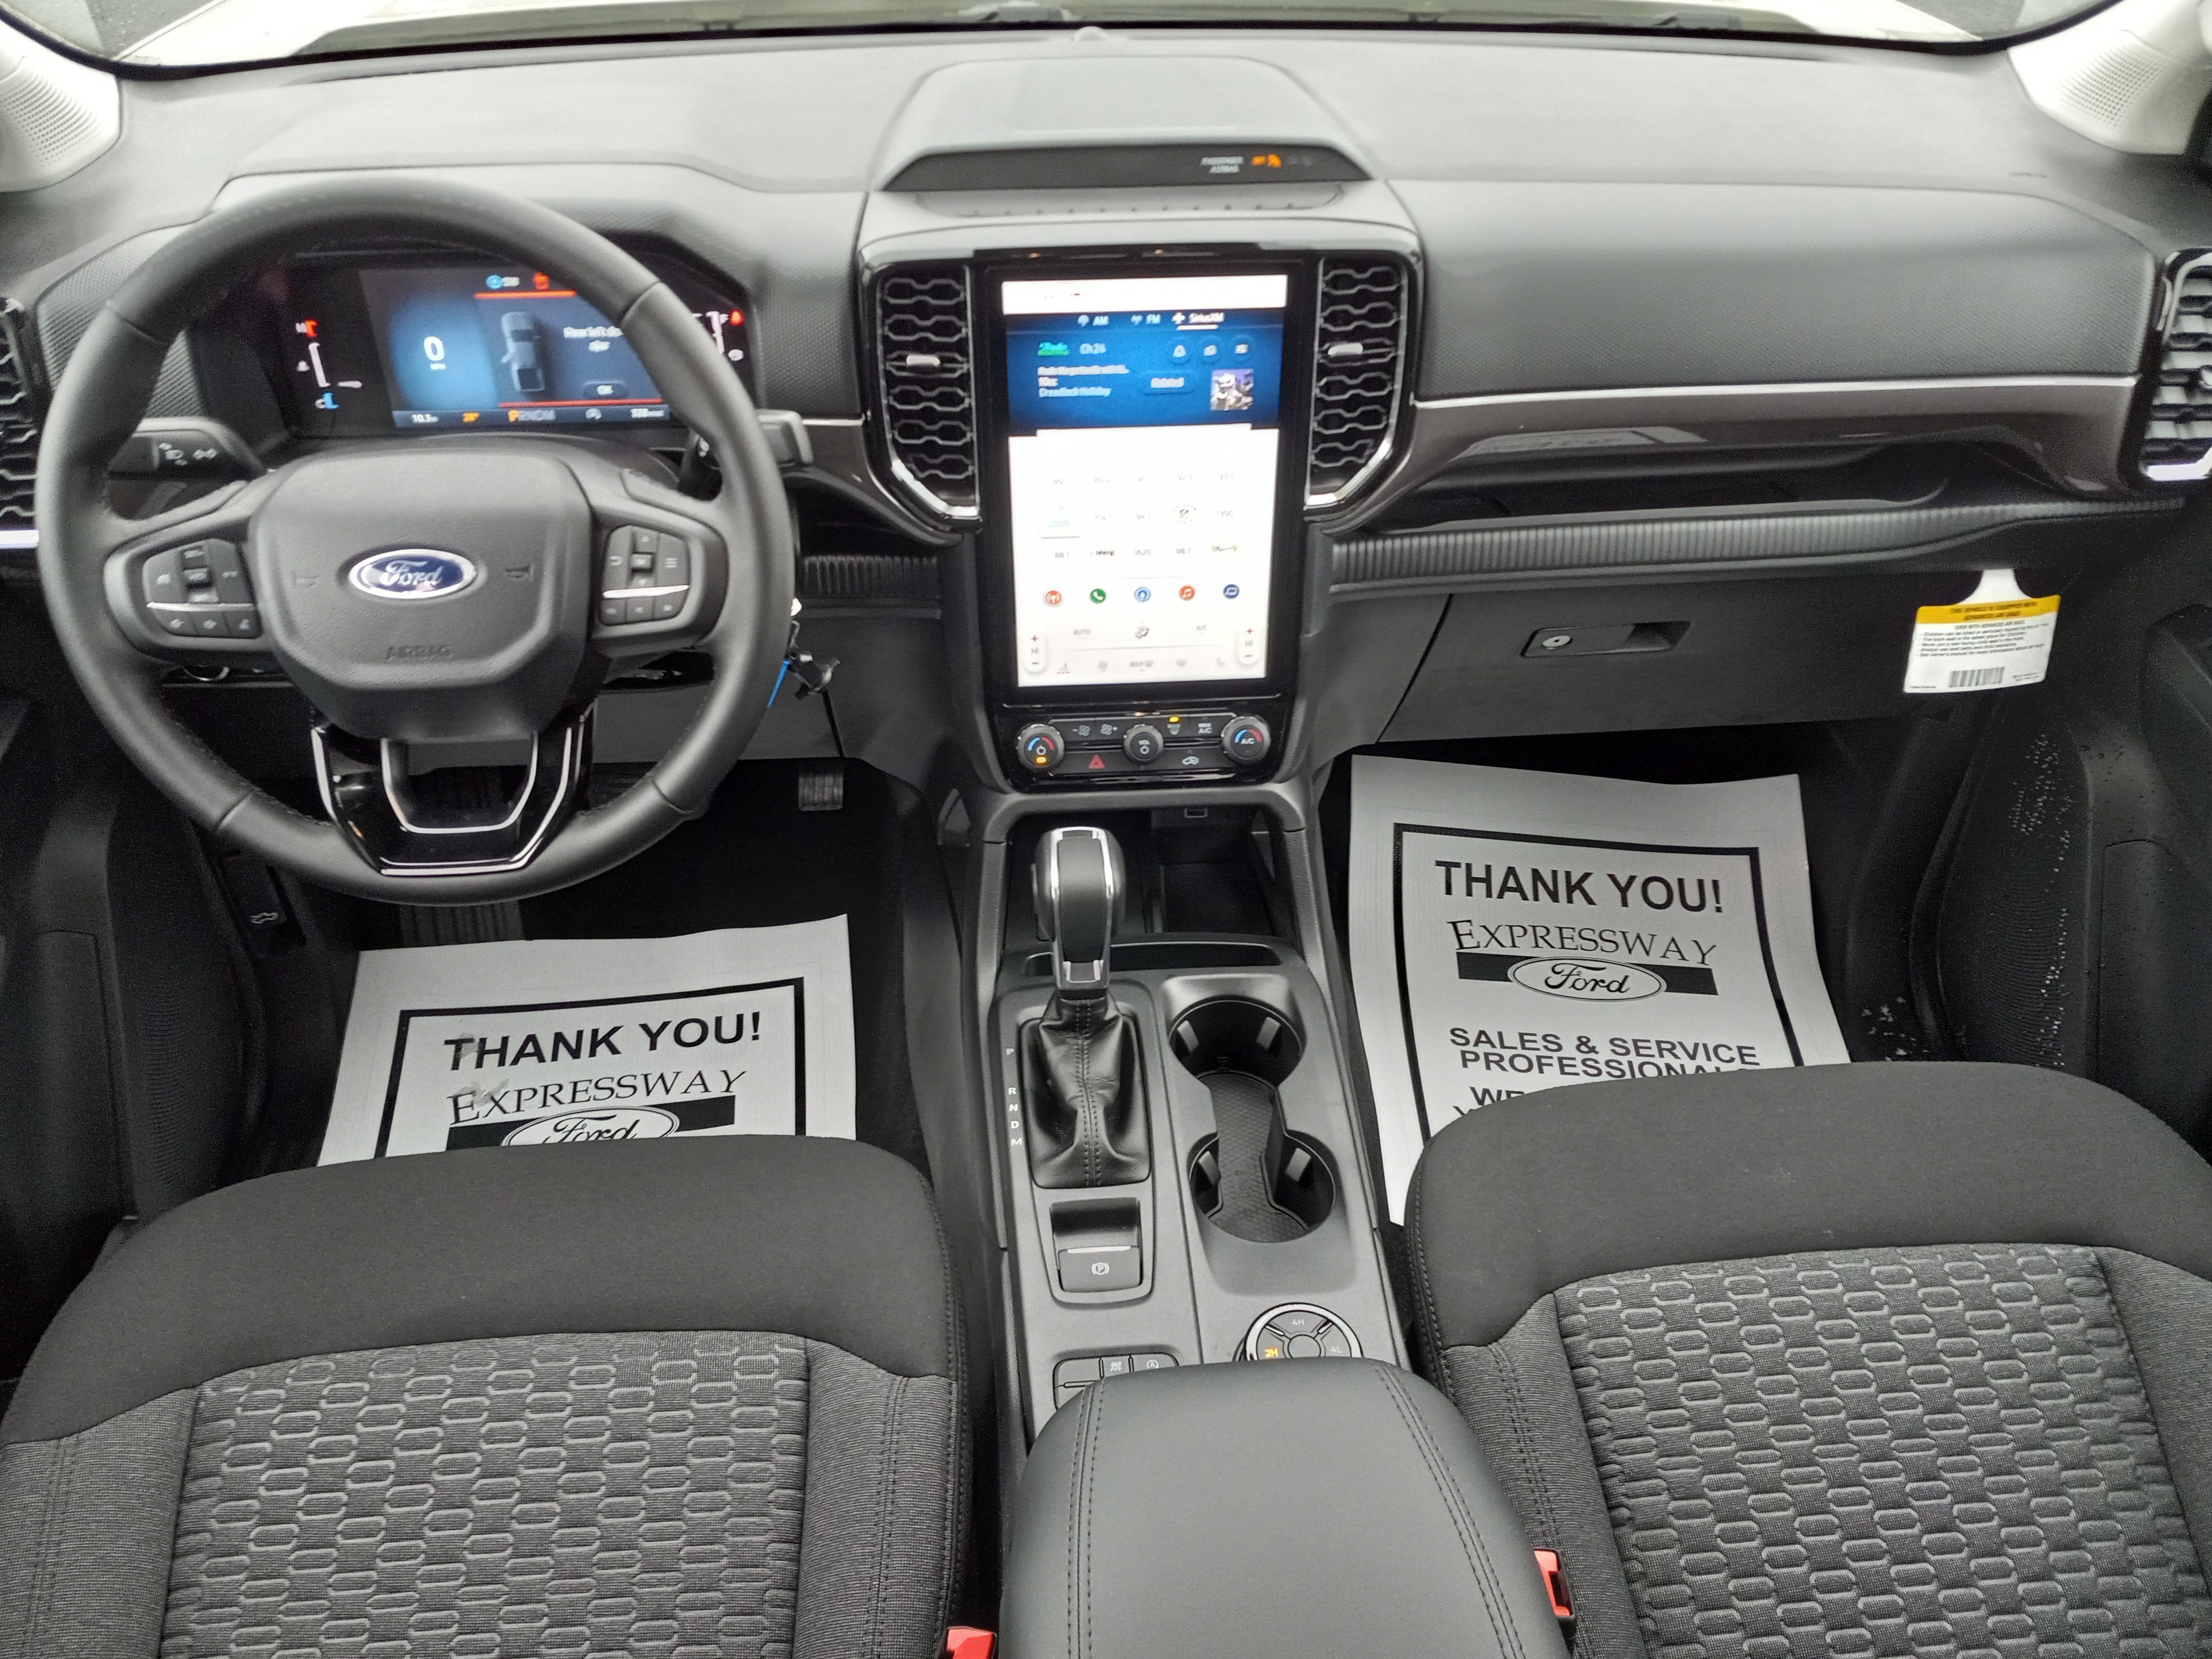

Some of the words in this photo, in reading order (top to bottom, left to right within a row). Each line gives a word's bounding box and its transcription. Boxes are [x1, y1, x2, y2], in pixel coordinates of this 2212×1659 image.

[1093, 316, 1109, 325] AM
[1146, 314, 1161, 324] FM
[424, 336, 445, 361] 0
[1435, 859, 1597, 907] THANK
[1607, 873, 1723, 914] YOU!
[1447, 919, 1717, 966] EXPRESSWAY
[1543, 963, 1631, 996] Ford
[444, 1025, 624, 1071] THANK
[638, 1011, 761, 1051] YOU!
[1450, 1028, 1563, 1052] SALES
[1575, 1035, 1600, 1055] &
[1610, 1037, 1760, 1066] SERVICE
[1460, 1049, 1746, 1080] PROFESSION
[447, 1070, 748, 1126] EXPRESSWAY
[1265, 1348, 1278, 1358] 2H
